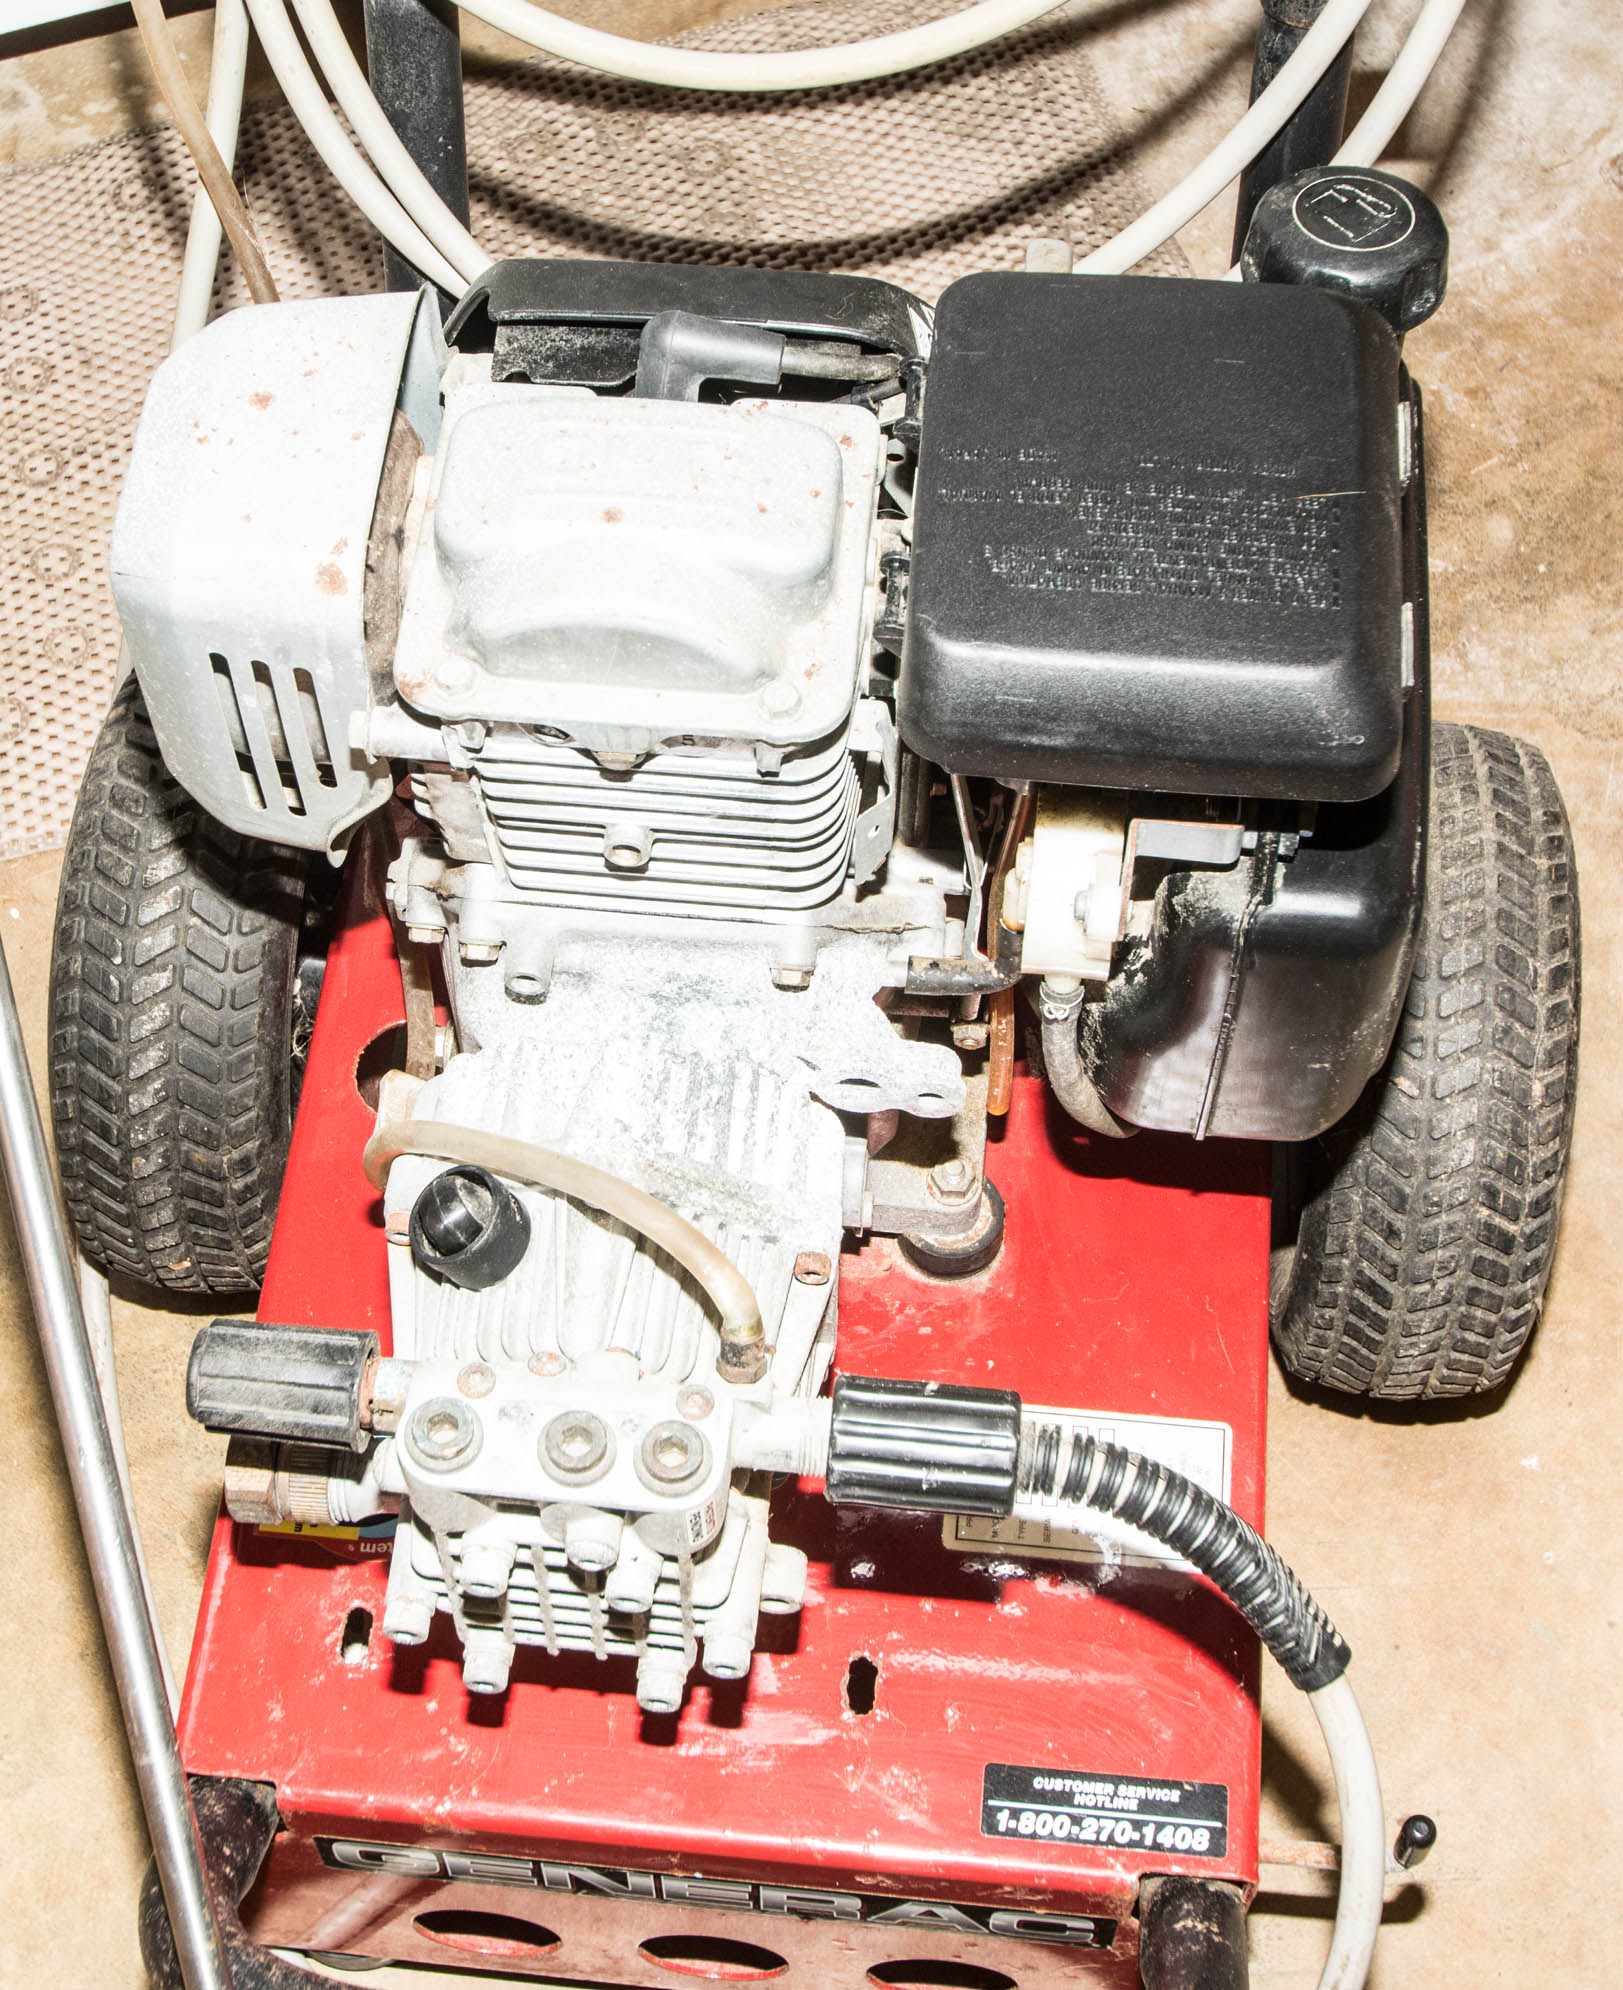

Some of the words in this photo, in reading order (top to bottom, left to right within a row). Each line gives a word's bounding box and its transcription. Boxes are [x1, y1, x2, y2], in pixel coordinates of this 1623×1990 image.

[1032, 1776, 1115, 1795] CUSTOMER
[1116, 1782, 1181, 1803] SERVICE
[1073, 1793, 1139, 1811] HOTLINE
[996, 1808, 1211, 1852] 1-800-270-1408
[329, 1838, 1098, 1945] GENERAC
